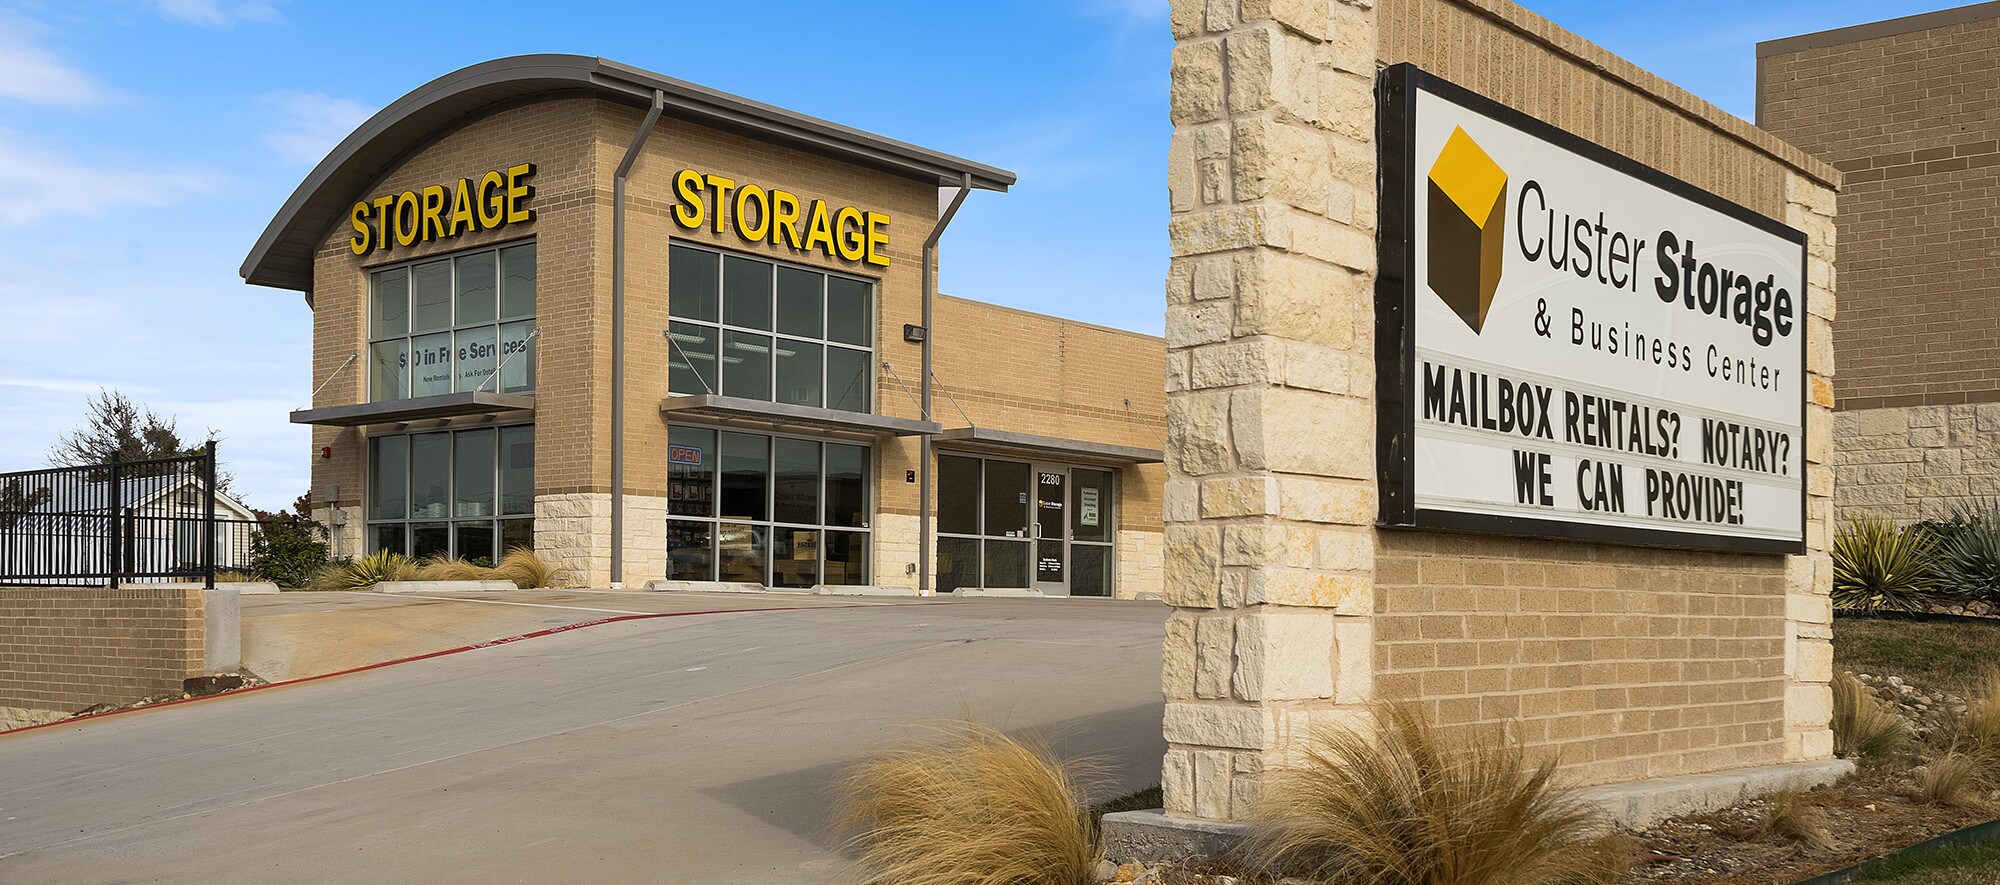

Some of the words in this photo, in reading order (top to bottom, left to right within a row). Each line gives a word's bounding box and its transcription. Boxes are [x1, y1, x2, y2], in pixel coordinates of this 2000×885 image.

[350, 163, 536, 256] STORAGE
[671, 168, 891, 268] STORAGE
[1517, 180, 1646, 293] Custer
[1654, 230, 1794, 347] Storage
[424, 349, 435, 365] in
[439, 346, 467, 364] Fre
[469, 339, 527, 359] Servces
[464, 370, 474, 378] Ask
[1535, 298, 1552, 338] &
[1571, 307, 1691, 372] Business
[1707, 344, 1780, 392] Center
[671, 448, 700, 463] OPEN
[1423, 362, 1554, 440] MAILBOX
[1565, 389, 1681, 460] RENTALS?
[1702, 418, 1790, 476] NOTARY?
[1041, 473, 1060, 485] 2280
[1514, 450, 1554, 506] WE
[1577, 459, 1625, 513] CAN
[1646, 468, 1745, 525] PROVIDE!
